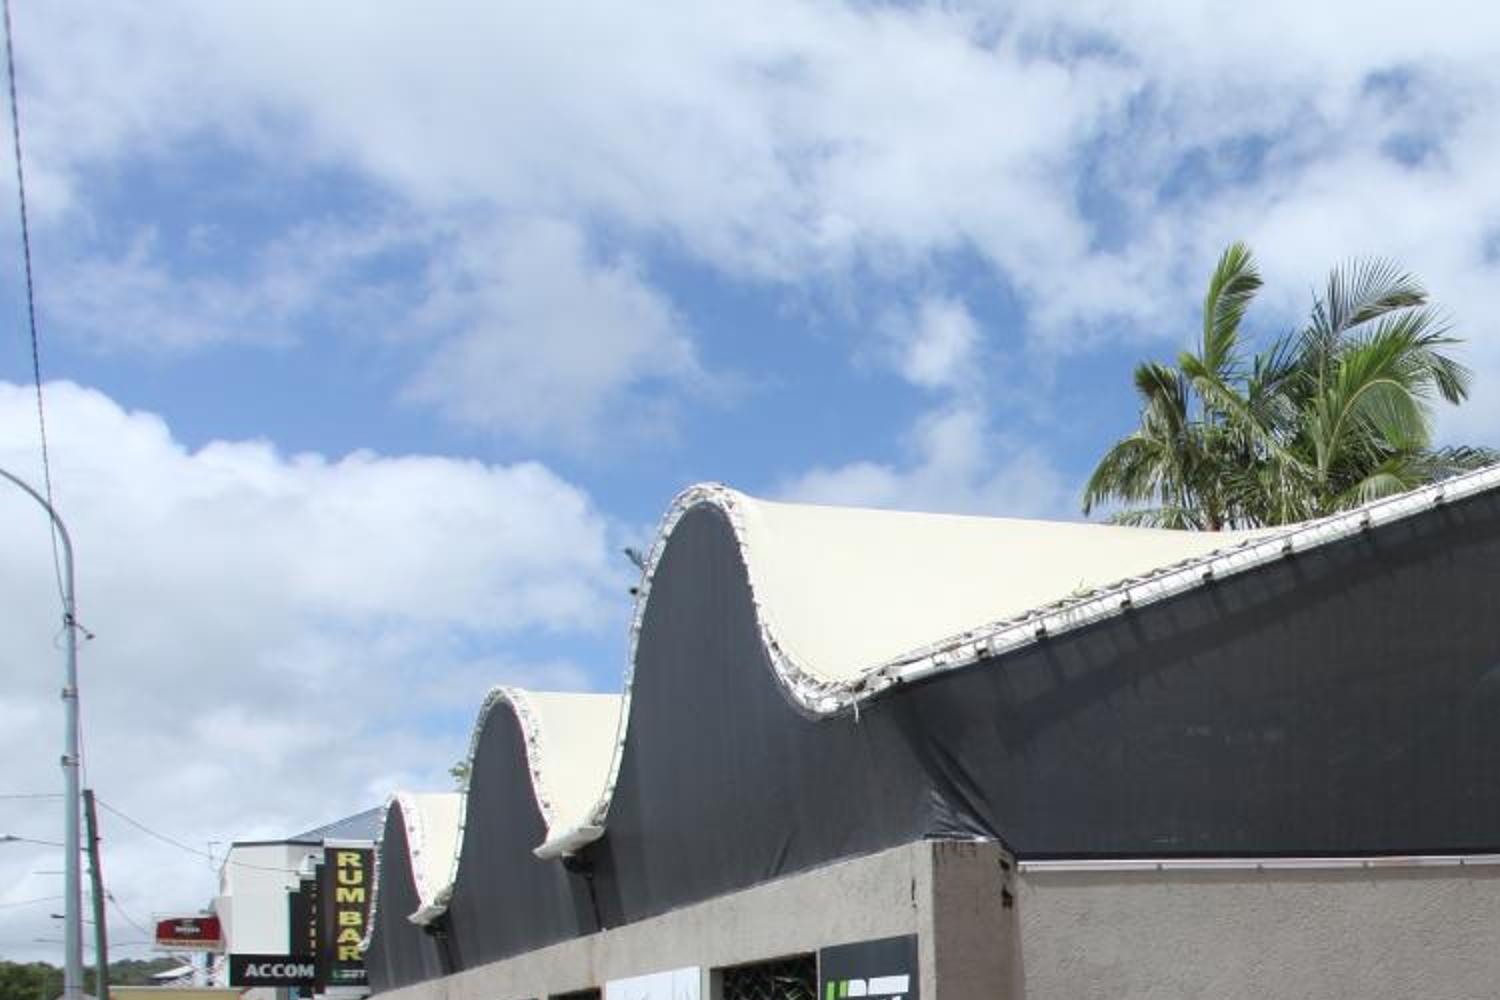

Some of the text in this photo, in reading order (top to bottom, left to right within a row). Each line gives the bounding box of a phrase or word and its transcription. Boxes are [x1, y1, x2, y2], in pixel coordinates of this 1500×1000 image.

[336, 851, 365, 960] RUM BAR
[245, 963, 315, 978] ACCOM
